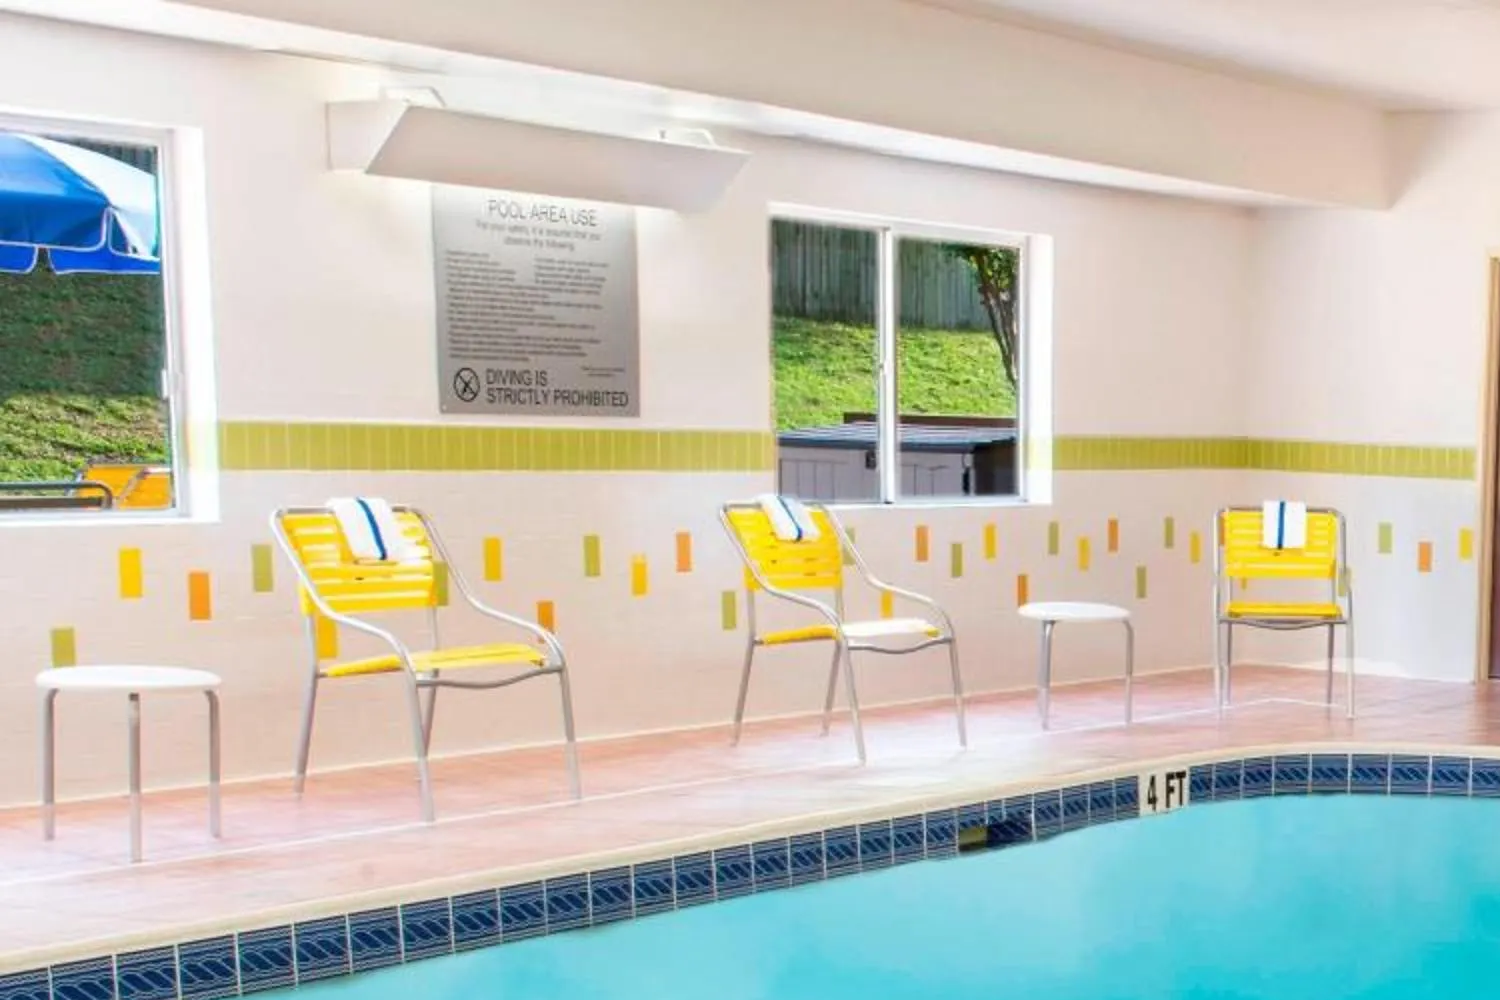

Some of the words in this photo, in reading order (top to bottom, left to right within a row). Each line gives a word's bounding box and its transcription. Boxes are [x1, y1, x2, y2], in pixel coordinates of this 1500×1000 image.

[488, 199, 526, 220] POOL
[530, 204, 568, 224] AREA
[571, 207, 598, 227] USE
[486, 368, 532, 386] DIVING
[535, 370, 548, 387] IS
[486, 387, 550, 405] STRICTLY
[553, 389, 629, 407] PROHIBITED
[1147, 774, 1158, 812] 4
[1165, 770, 1186, 808] FT
